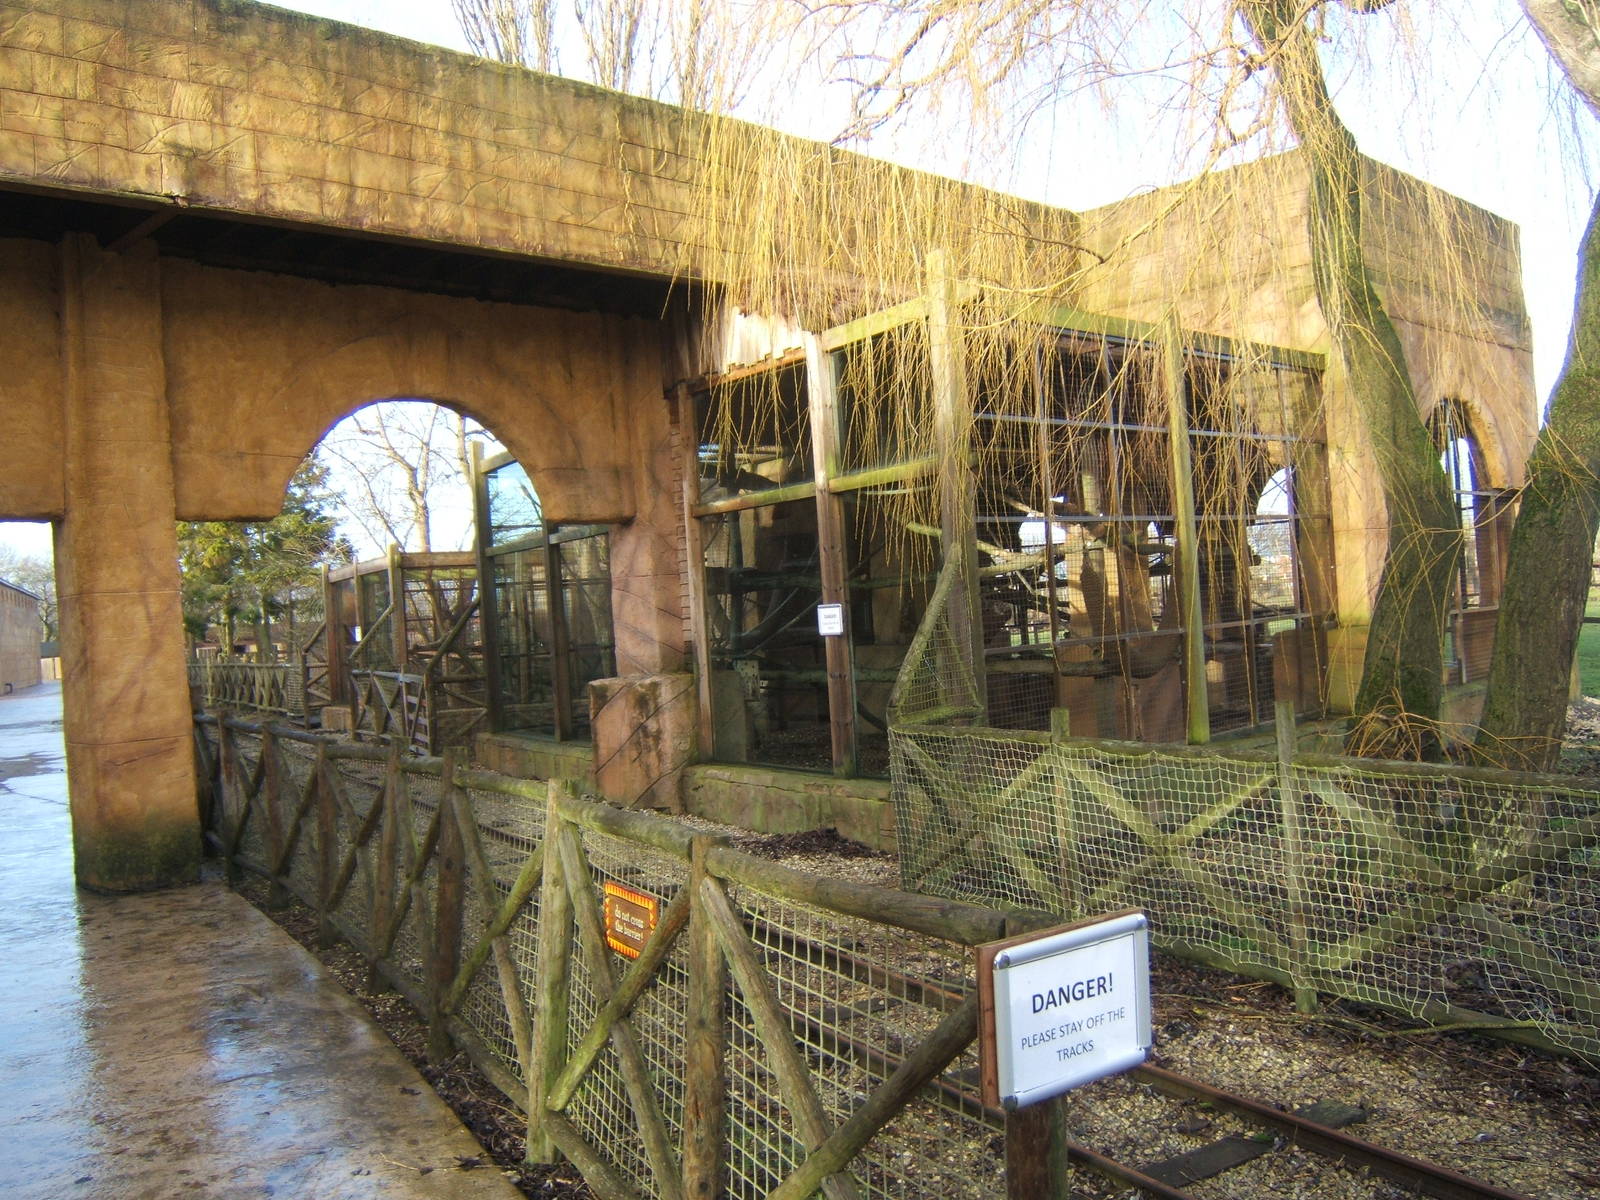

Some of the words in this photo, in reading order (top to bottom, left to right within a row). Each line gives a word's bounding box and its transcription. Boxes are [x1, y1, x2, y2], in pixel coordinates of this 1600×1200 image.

[1032, 972, 1113, 1014] DANGER!
[1021, 1027, 1056, 1050] PLEASE
[1059, 1019, 1084, 1038] STAY
[1086, 1014, 1104, 1030] OFF
[1108, 1006, 1125, 1021] THE
[1057, 1040, 1094, 1061] TRACKS
